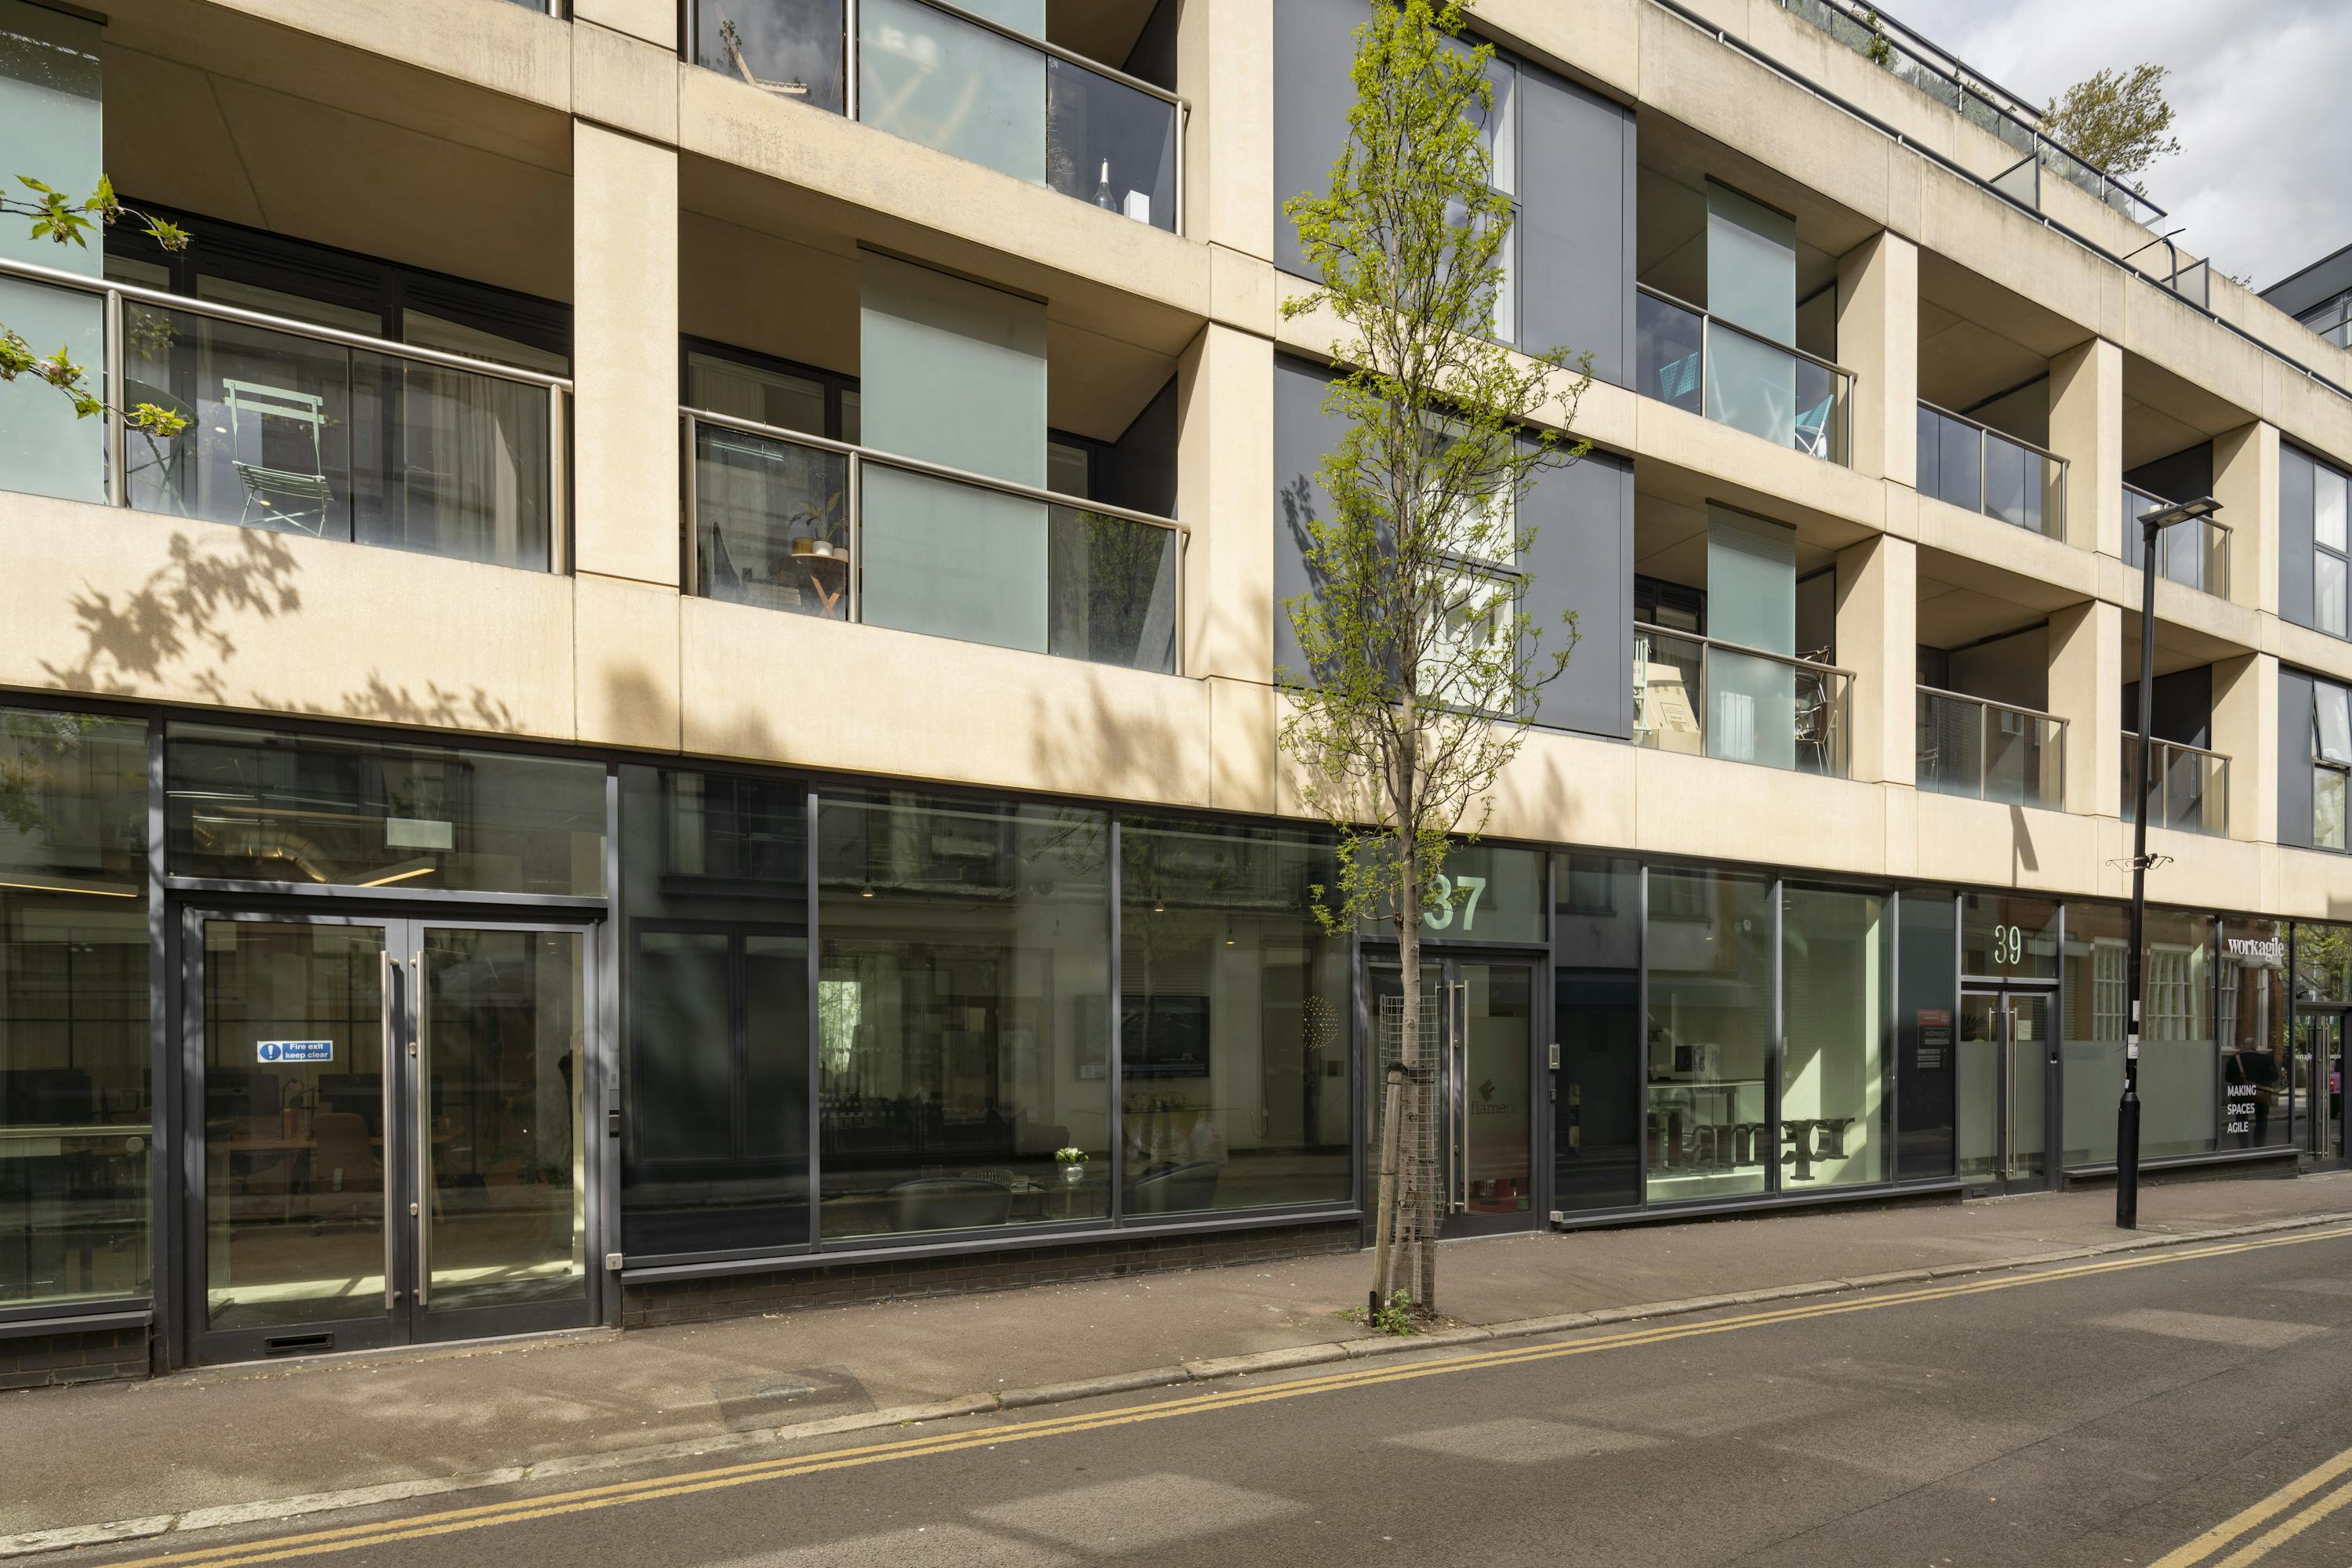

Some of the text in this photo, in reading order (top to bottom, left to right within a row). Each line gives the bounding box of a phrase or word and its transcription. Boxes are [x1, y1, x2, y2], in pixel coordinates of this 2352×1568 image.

[1424, 873, 1486, 931] 37
[1994, 925, 2021, 964] 39
[2227, 937, 2285, 962] workagile
[2227, 1084, 2257, 1097] MAKING
[2227, 1102, 2256, 1115] SPACES
[2227, 1121, 2249, 1134] AGILE
